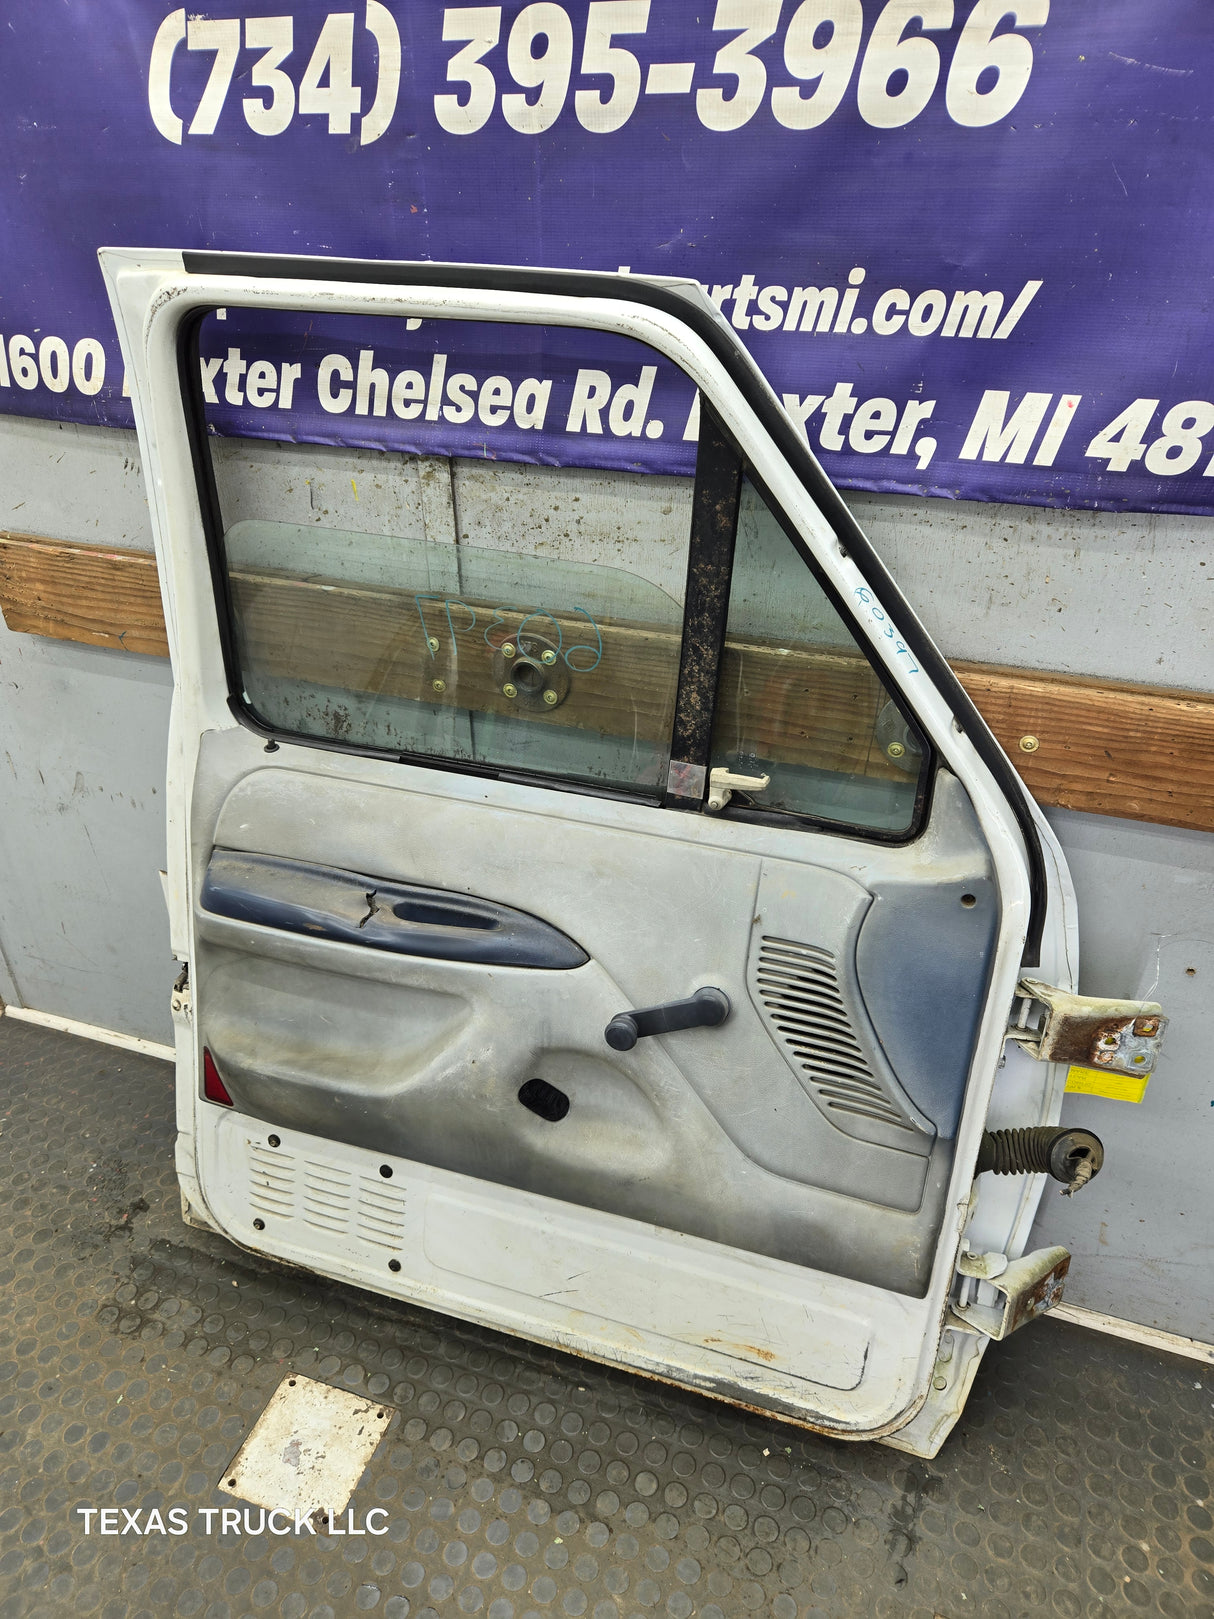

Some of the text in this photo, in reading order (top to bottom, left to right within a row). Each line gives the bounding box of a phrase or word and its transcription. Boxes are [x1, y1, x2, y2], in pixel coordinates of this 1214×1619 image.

[148, 0, 1050, 145] (734) 395-3966
[700, 268, 1043, 339] rtsmi.com/
[316, 350, 552, 430] Chelsea
[566, 366, 664, 440] Rd.
[958, 390, 1083, 466] MI
[1084, 398, 1214, 477] 48
